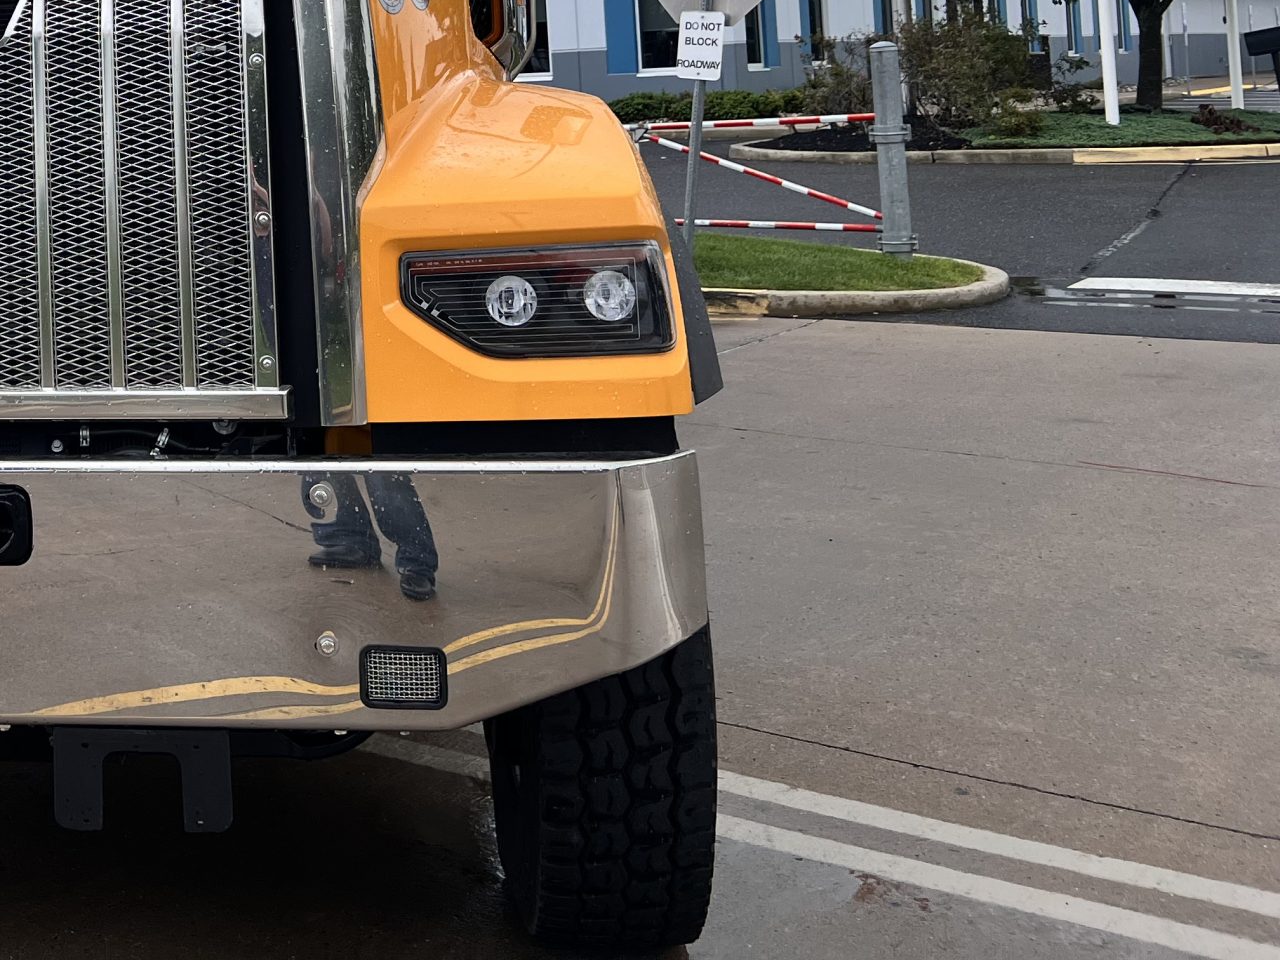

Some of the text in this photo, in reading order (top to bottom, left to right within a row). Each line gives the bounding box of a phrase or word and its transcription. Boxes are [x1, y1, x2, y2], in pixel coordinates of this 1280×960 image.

[685, 22, 722, 31] DO NOT
[685, 37, 718, 46] BLOCK
[676, 59, 720, 69] ROADWAY
